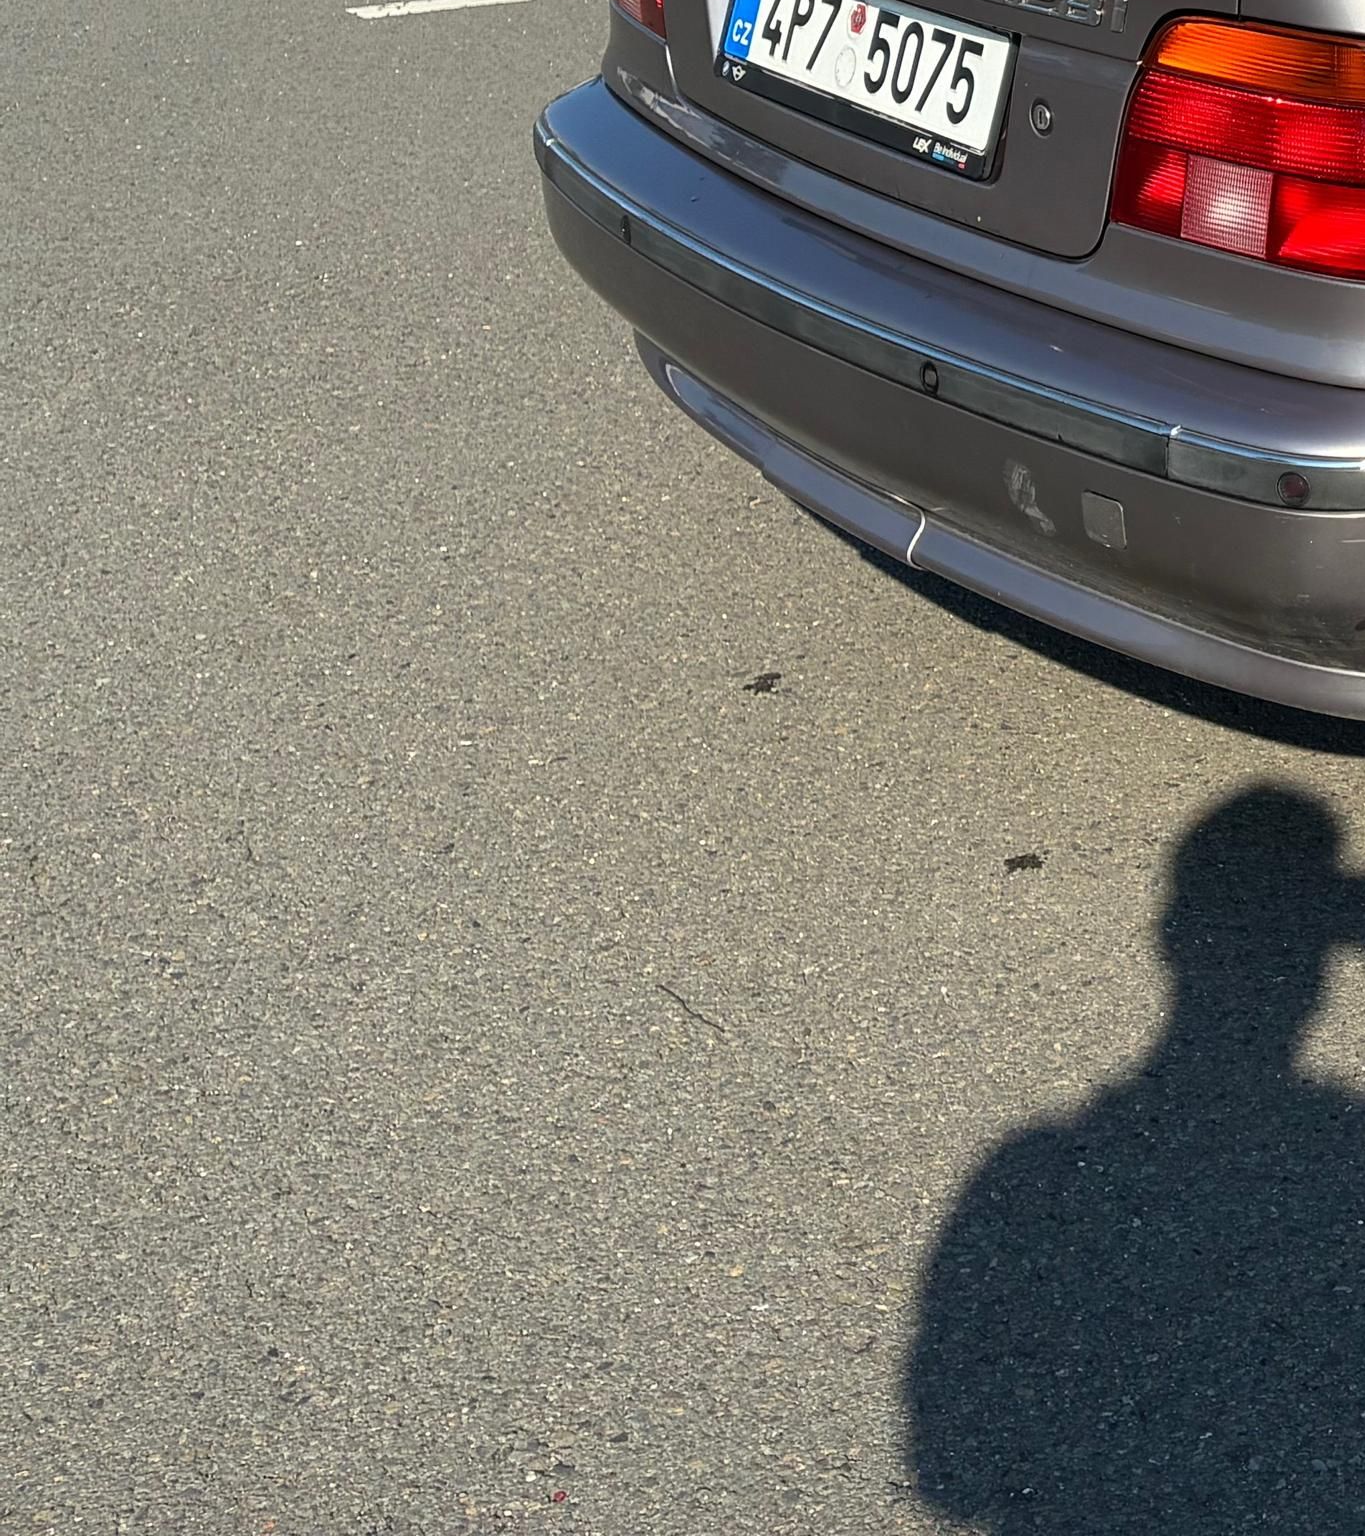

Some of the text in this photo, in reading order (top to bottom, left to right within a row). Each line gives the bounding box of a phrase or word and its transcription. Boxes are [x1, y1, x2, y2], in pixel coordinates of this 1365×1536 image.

[731, 18, 752, 46] CZ
[864, 9, 985, 125] 5075
[912, 136, 933, 154] LEX
